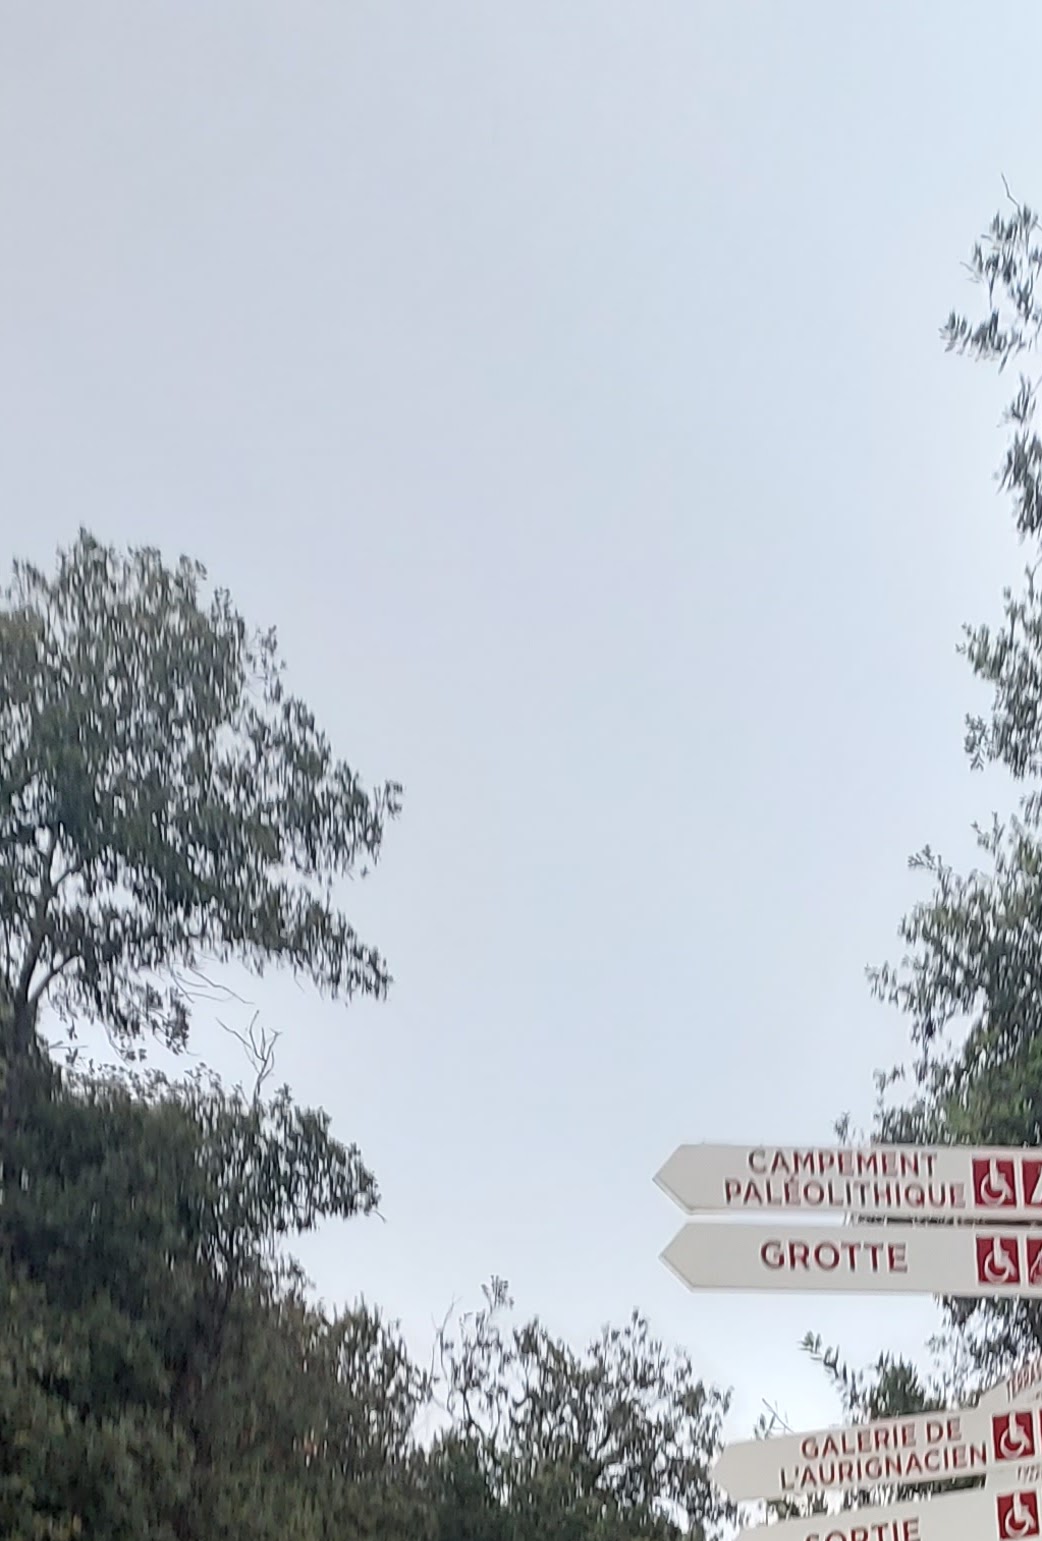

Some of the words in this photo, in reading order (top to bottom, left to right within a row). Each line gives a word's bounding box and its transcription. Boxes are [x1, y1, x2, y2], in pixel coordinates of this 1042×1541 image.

[747, 1149, 938, 1178] CAMPEMENT
[724, 1176, 966, 1209] PALÉOLITHIQUE
[759, 1241, 909, 1274] GROTTE
[801, 1420, 917, 1461] GALERIE
[926, 1416, 962, 1443] DE
[779, 1440, 988, 1492] L'AURIGNACIEN
